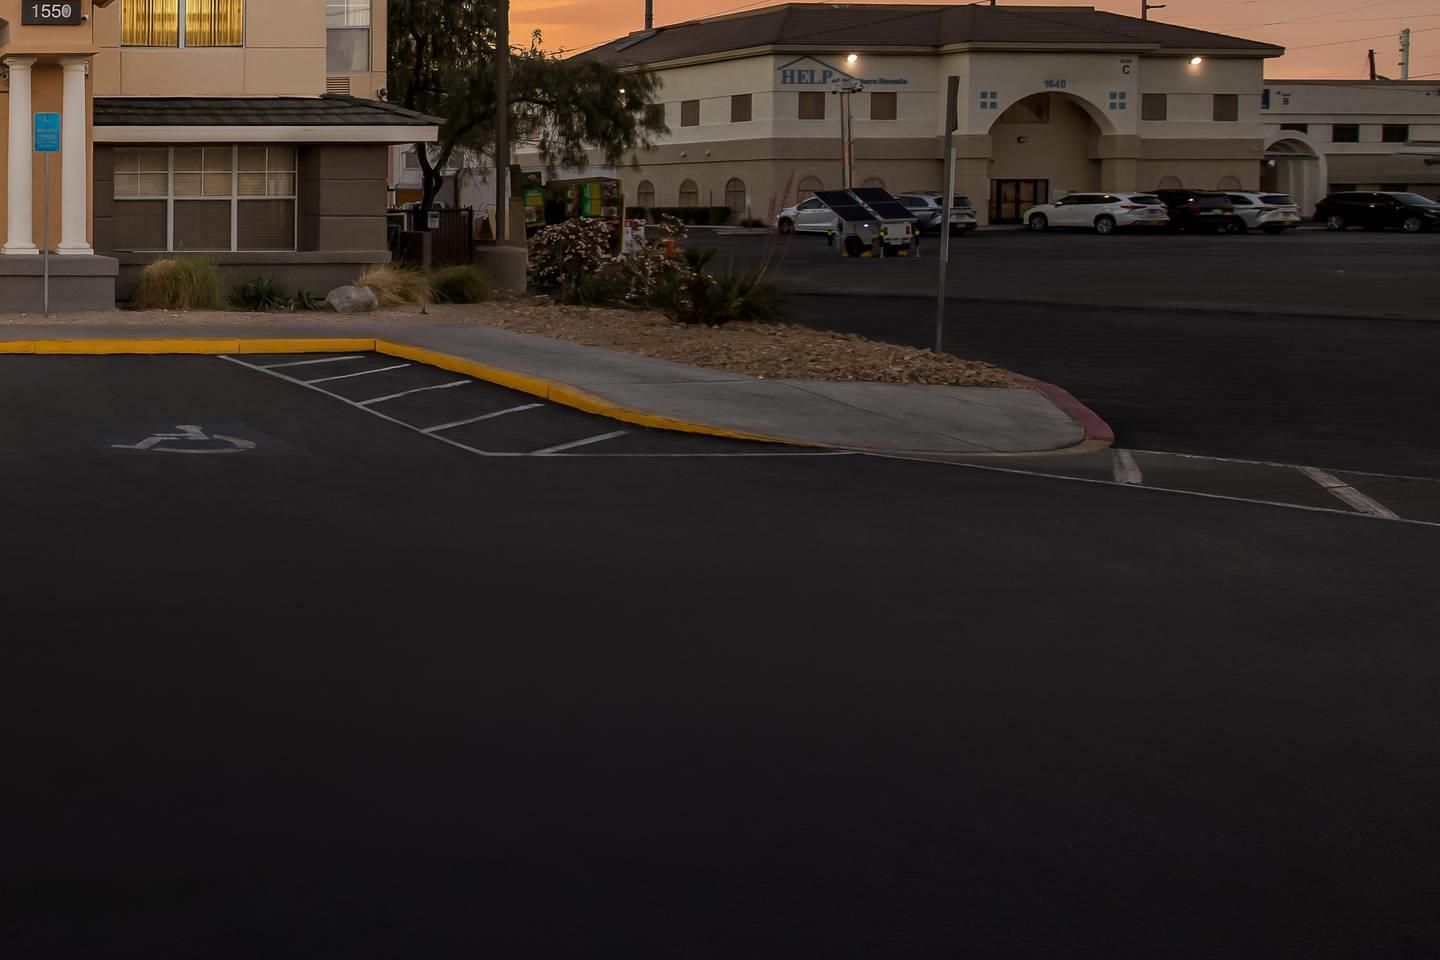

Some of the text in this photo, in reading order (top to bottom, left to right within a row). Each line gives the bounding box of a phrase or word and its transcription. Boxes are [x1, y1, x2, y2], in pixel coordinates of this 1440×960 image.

[32, 4, 72, 18] 1550
[781, 69, 833, 84] HELP
[1121, 64, 1130, 75] C
